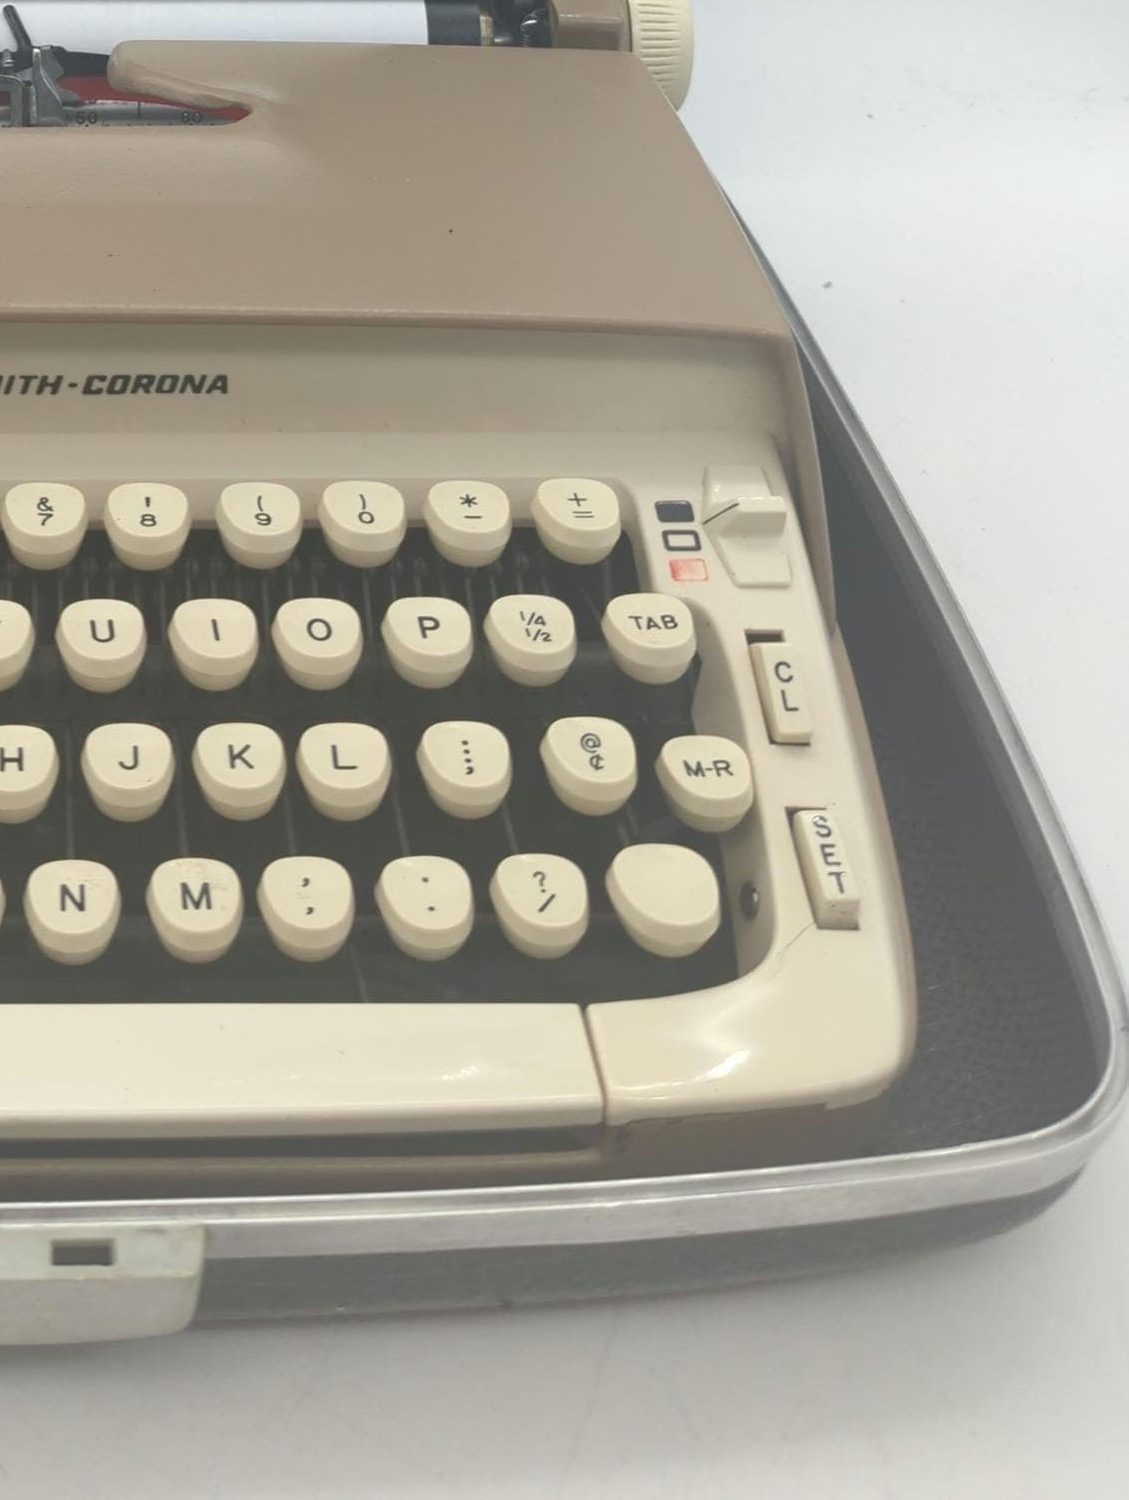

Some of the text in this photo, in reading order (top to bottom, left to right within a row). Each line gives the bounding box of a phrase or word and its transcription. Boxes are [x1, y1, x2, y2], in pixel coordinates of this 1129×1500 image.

[76, 111, 98, 124] 50
[36, 496, 54, 515] &
[37, 512, 54, 527] 7
[139, 513, 157, 528] 8
[254, 512, 272, 527] 9
[89, 619, 116, 644] U
[306, 617, 333, 642] O
[417, 615, 441, 639] P
[628, 614, 679, 631] TAB
[579, 732, 602, 754] @
[118, 745, 139, 771] J
[227, 744, 255, 770] K
[330, 744, 358, 771] L
[682, 759, 734, 778] M-R
[812, 814, 846, 894] SET
[532, 870, 547, 894] ?
[60, 883, 86, 912] N
[180, 882, 213, 911] M
